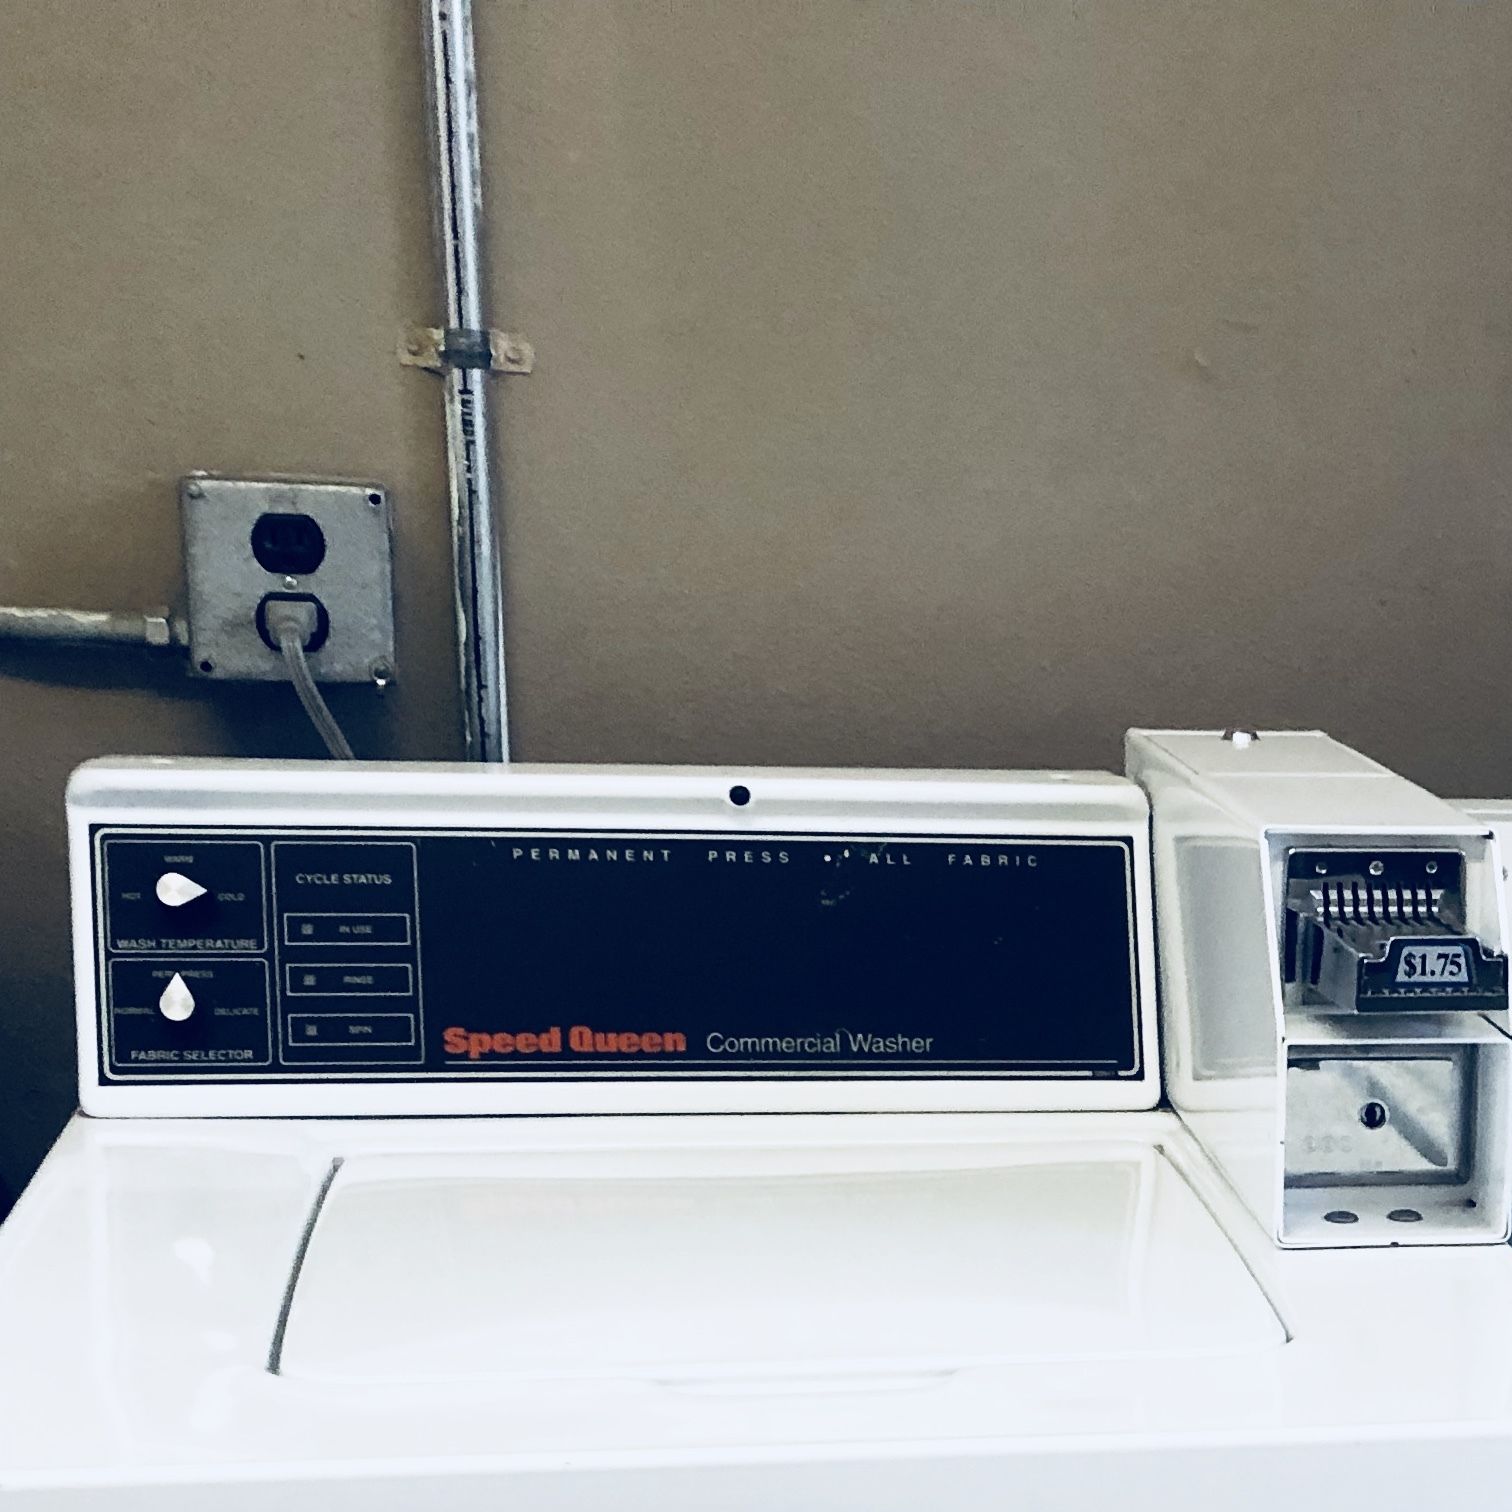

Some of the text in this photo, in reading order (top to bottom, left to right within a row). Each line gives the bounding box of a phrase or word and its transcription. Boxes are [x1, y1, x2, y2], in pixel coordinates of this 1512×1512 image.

[513, 847, 1040, 868] PERMANENT PRESS ALL FABRIC
[295, 873, 392, 885] CYCLE STATUS
[121, 892, 141, 900] HOT
[217, 892, 246, 902] COLD
[338, 925, 373, 934] IN USE
[116, 938, 258, 949] WASH TEMPERATURE
[1402, 949, 1463, 979] $1.75
[343, 975, 375, 984] RINSE
[214, 1007, 260, 1016] DELICATE
[348, 1025, 373, 1034] SPIN
[443, 1026, 686, 1060] Speed Queen
[706, 1030, 933, 1055] Commercial Washer
[130, 1049, 254, 1061] FABRIC SELECTOR
